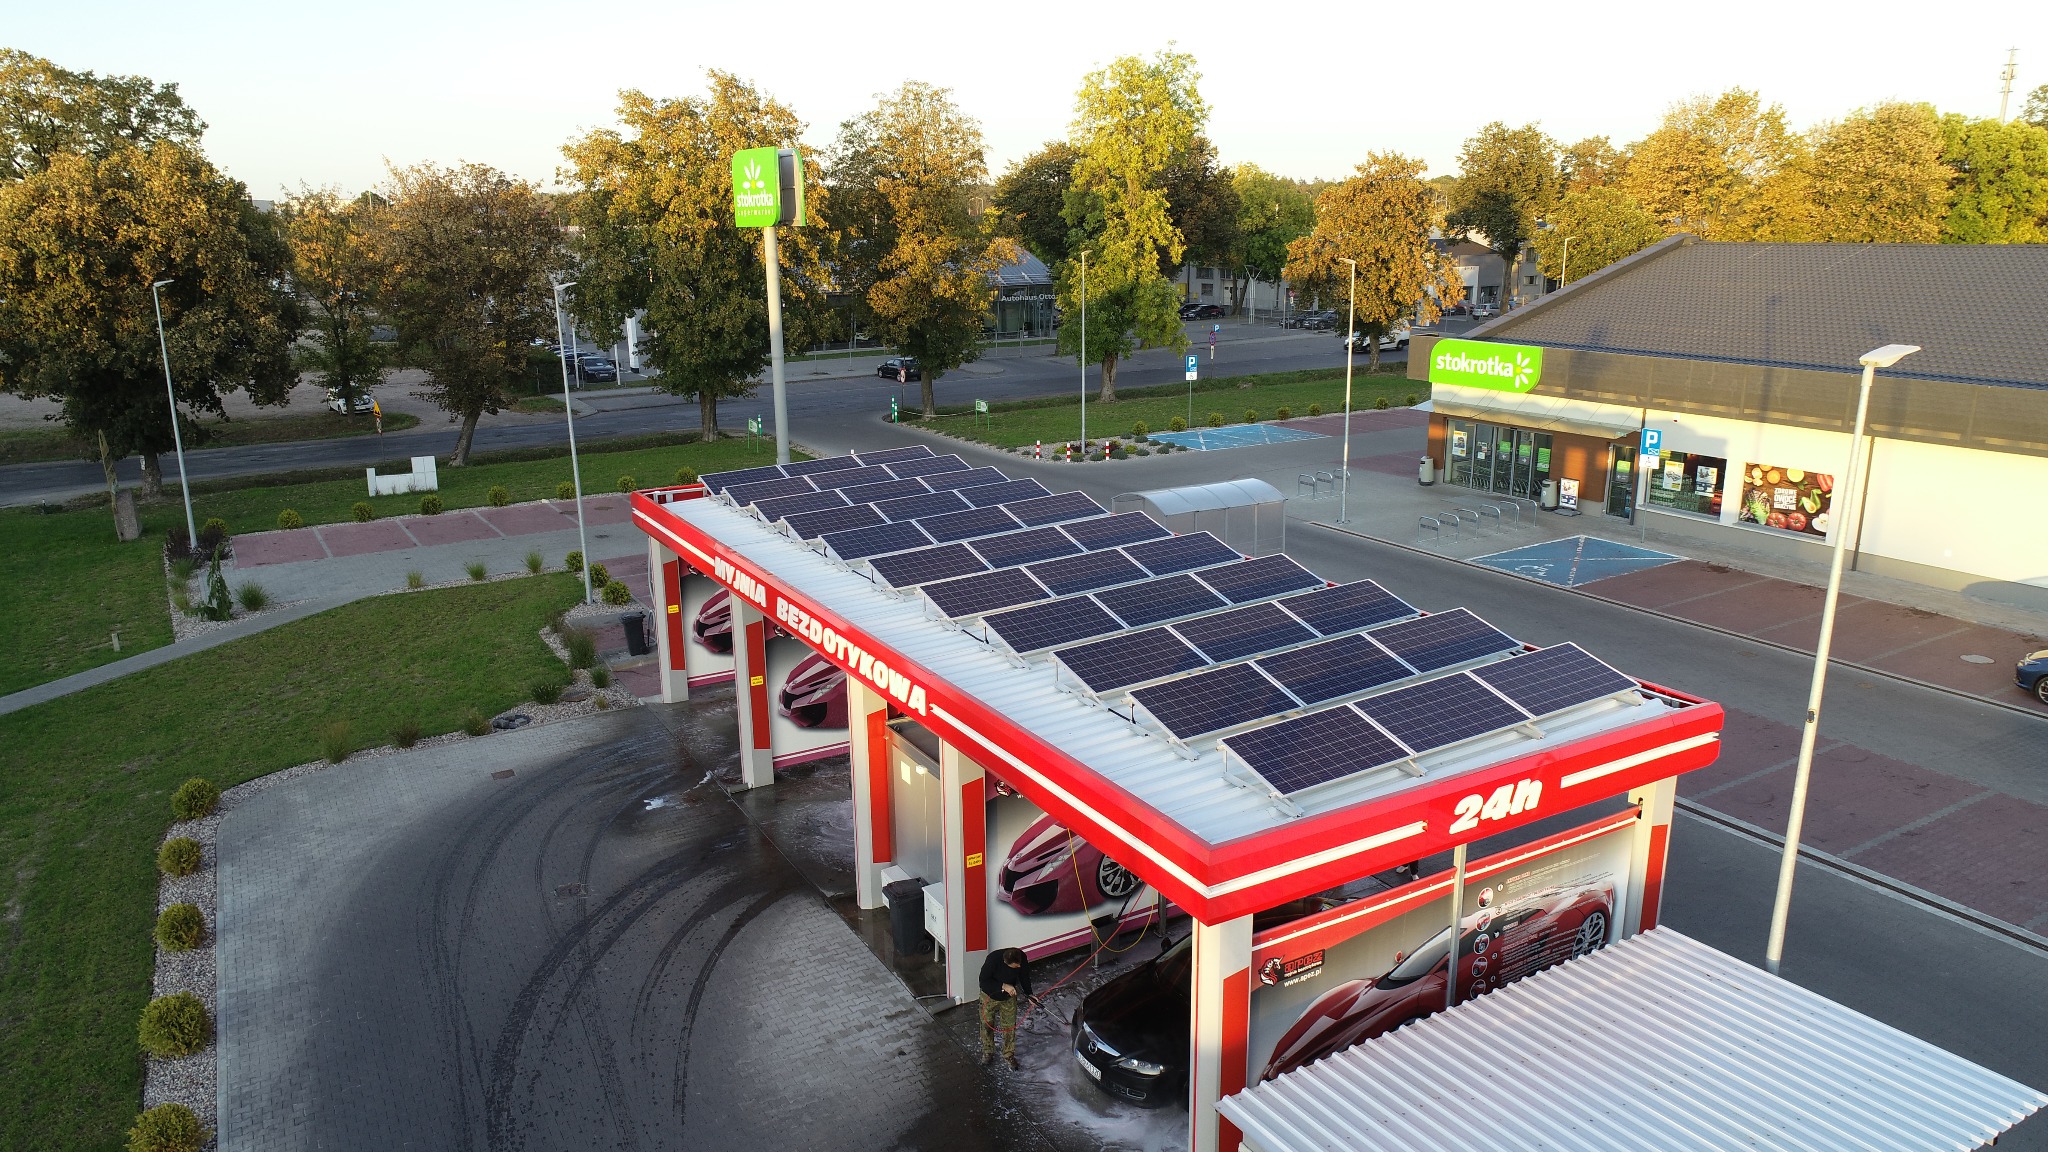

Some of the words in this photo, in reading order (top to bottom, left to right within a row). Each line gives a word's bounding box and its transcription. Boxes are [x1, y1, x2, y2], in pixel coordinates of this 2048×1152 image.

[737, 189, 774, 207] stokrotka
[737, 208, 774, 217] supermarket
[1188, 356, 1196, 367] P
[1436, 352, 1514, 377] stokrotka
[1645, 431, 1659, 448] P
[714, 556, 767, 608] MYJNIA
[776, 596, 927, 717] BEZDOTYKOWA
[1449, 778, 1543, 835] 24h
[1283, 967, 1322, 987] www.apez.pl
